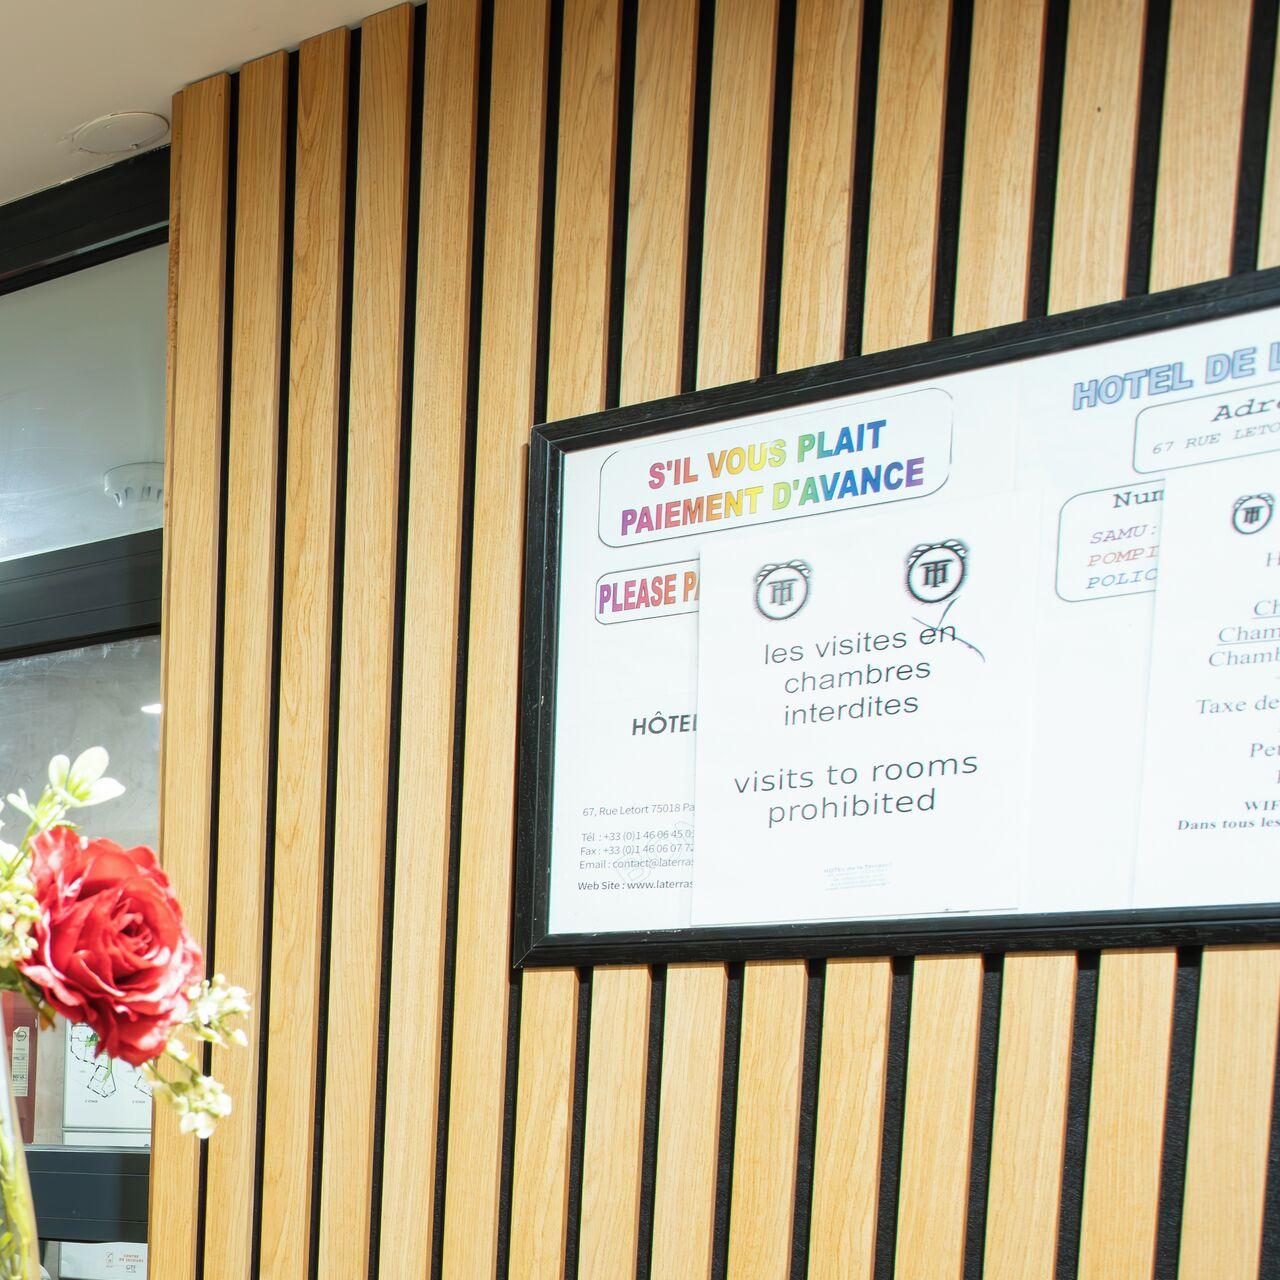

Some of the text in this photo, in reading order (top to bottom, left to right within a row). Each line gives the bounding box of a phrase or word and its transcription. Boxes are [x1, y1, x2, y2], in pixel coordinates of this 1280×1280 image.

[1072, 361, 1194, 411] HOTEL
[1205, 346, 1257, 385] DE
[648, 419, 887, 490] S'IL VOUS PLAIT
[1152, 441, 1174, 454] 67
[1185, 432, 1221, 450] RUE
[621, 457, 925, 537] PAIEMENT D'AVANCE
[598, 573, 677, 615] PLEASE
[764, 624, 956, 665] les visites en
[784, 662, 931, 693] chambres
[784, 696, 919, 726] interdites
[1196, 698, 1247, 714] Taxe
[735, 755, 978, 793] visits to rooms
[599, 806, 617, 815] Rue
[620, 805, 648, 814] Letort
[651, 803, 680, 813] 75018
[769, 788, 935, 828] prohibited
[603, 832, 621, 841] +33
[1178, 819, 1216, 830] Dans
[1222, 818, 1255, 829] tous
[579, 859, 606, 869] Email
[580, 847, 596, 856] Fax
[577, 881, 600, 890] Web
[601, 880, 620, 890] Site
